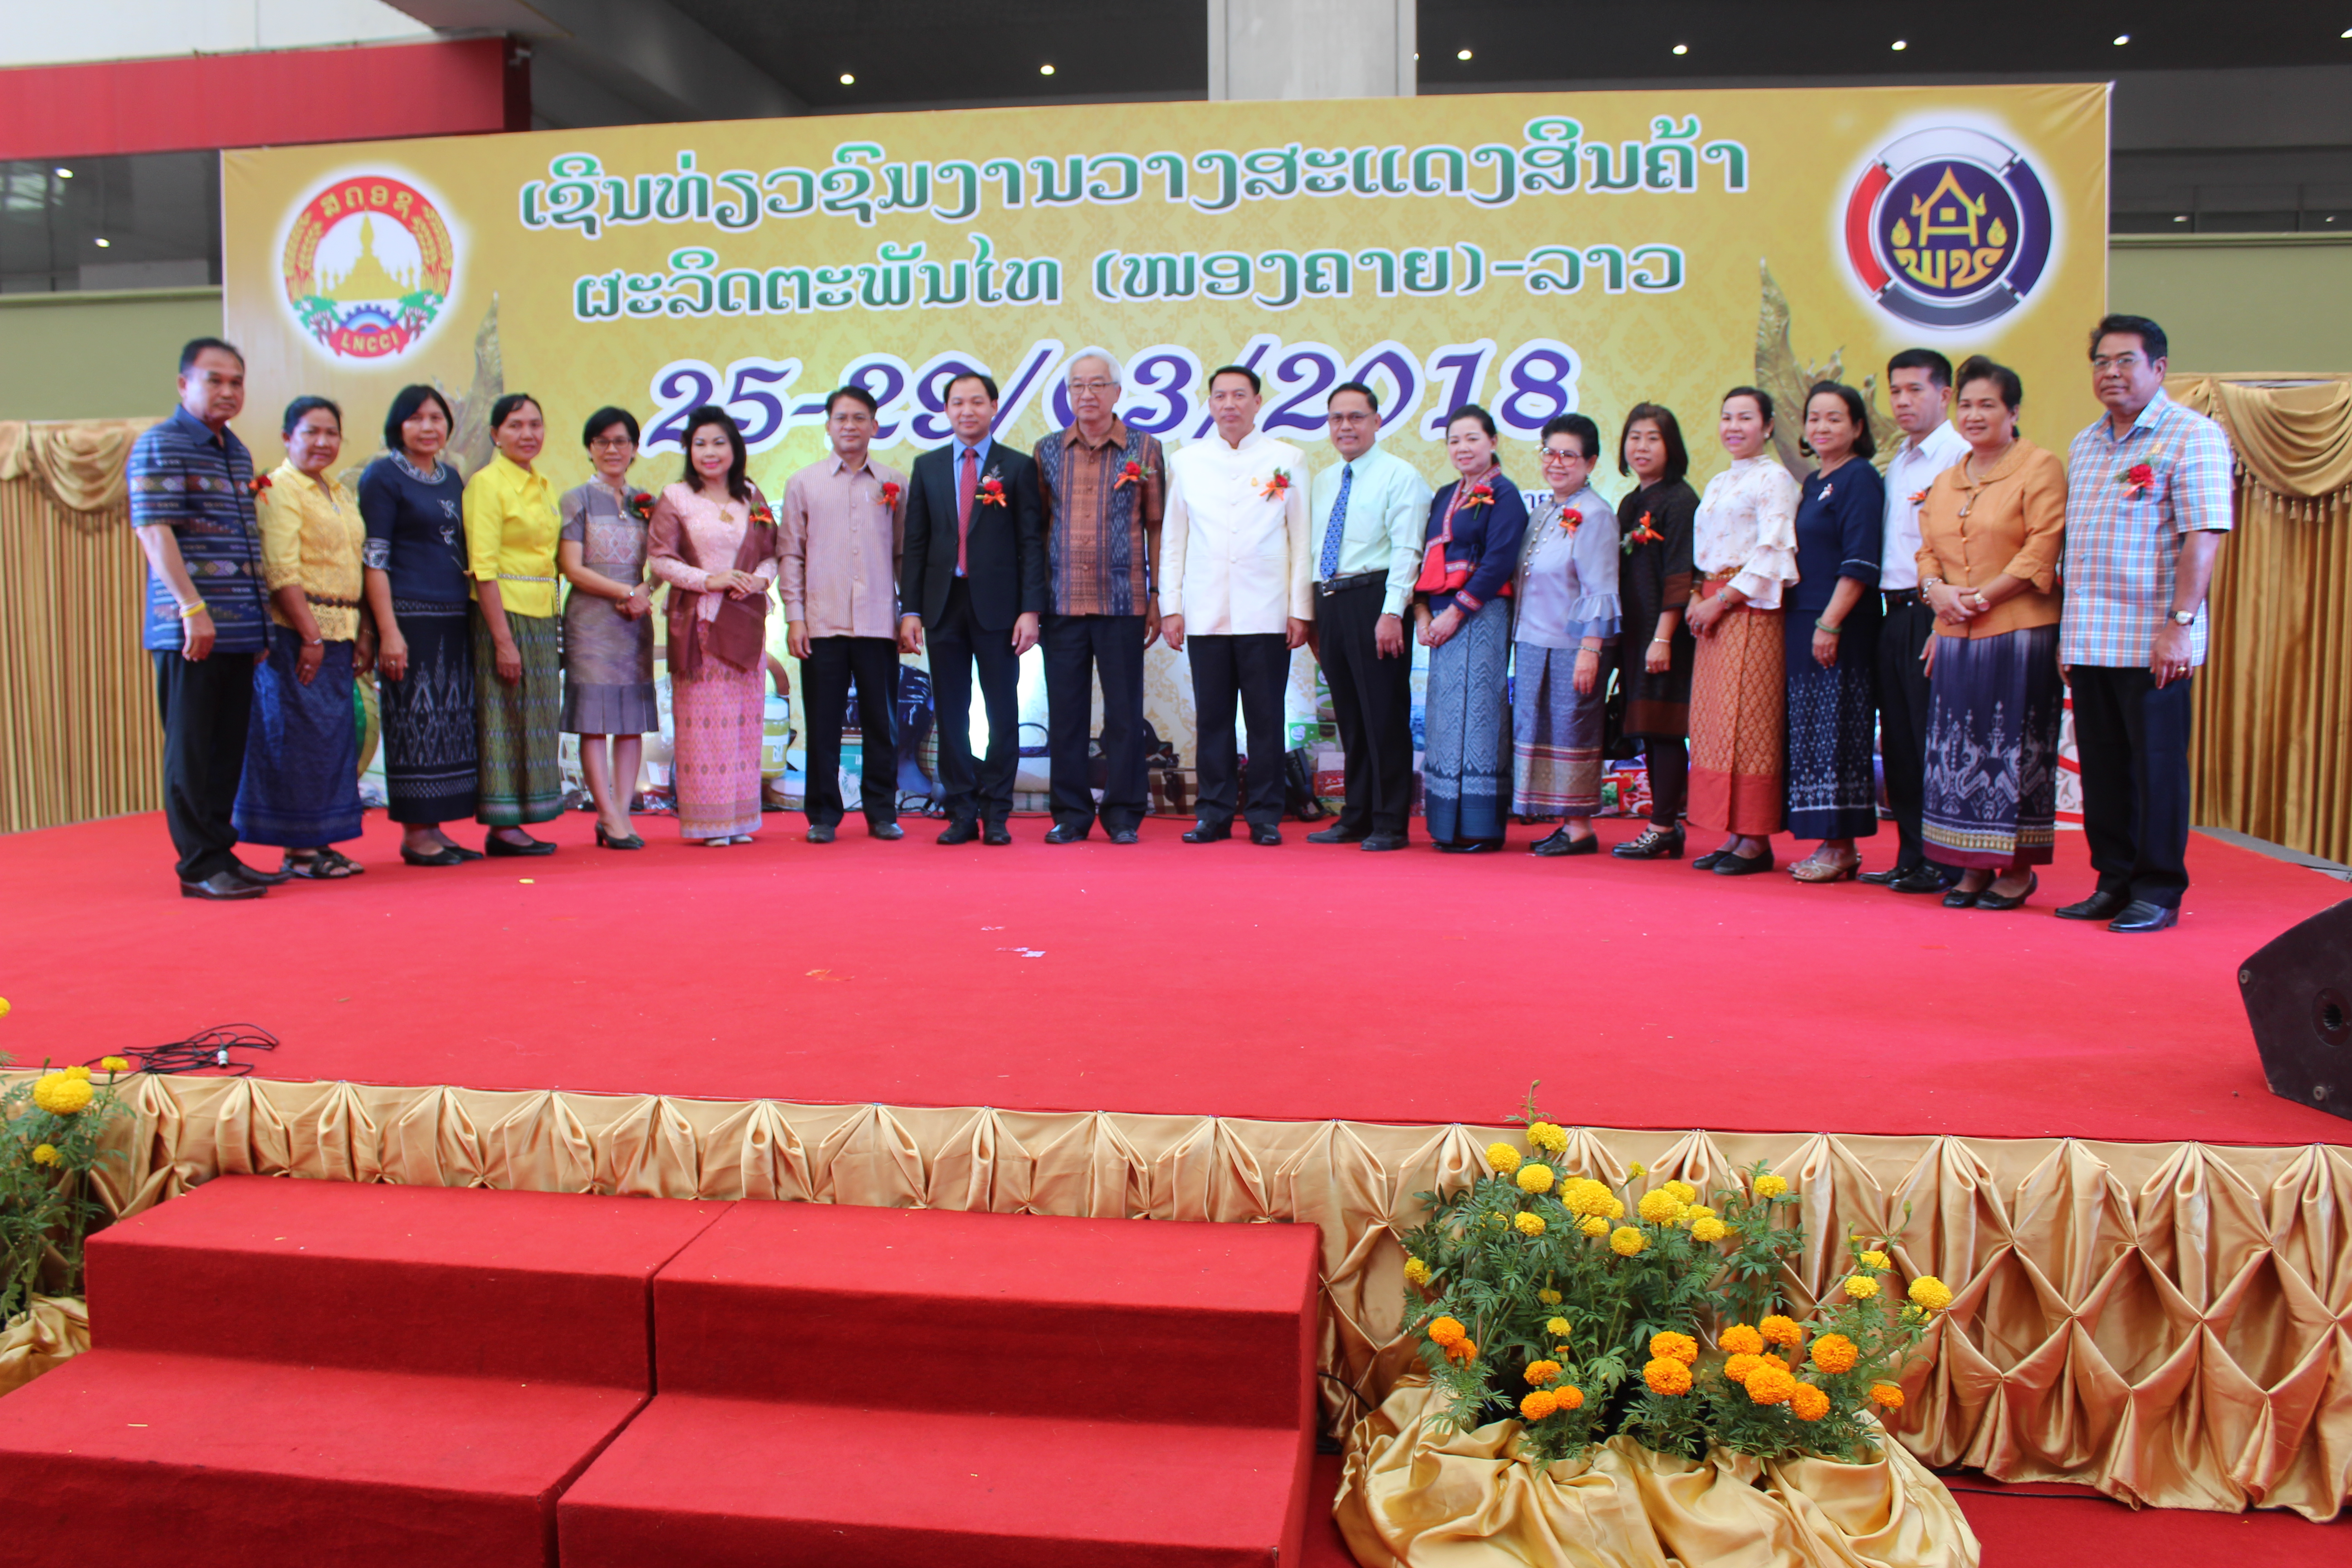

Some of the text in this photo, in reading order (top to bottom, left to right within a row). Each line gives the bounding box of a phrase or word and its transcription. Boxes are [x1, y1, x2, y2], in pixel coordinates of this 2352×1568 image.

[575, 234, 1059, 317] ຜະລິດຕະພັນໄທ
[340, 330, 399, 353] LNCCI
